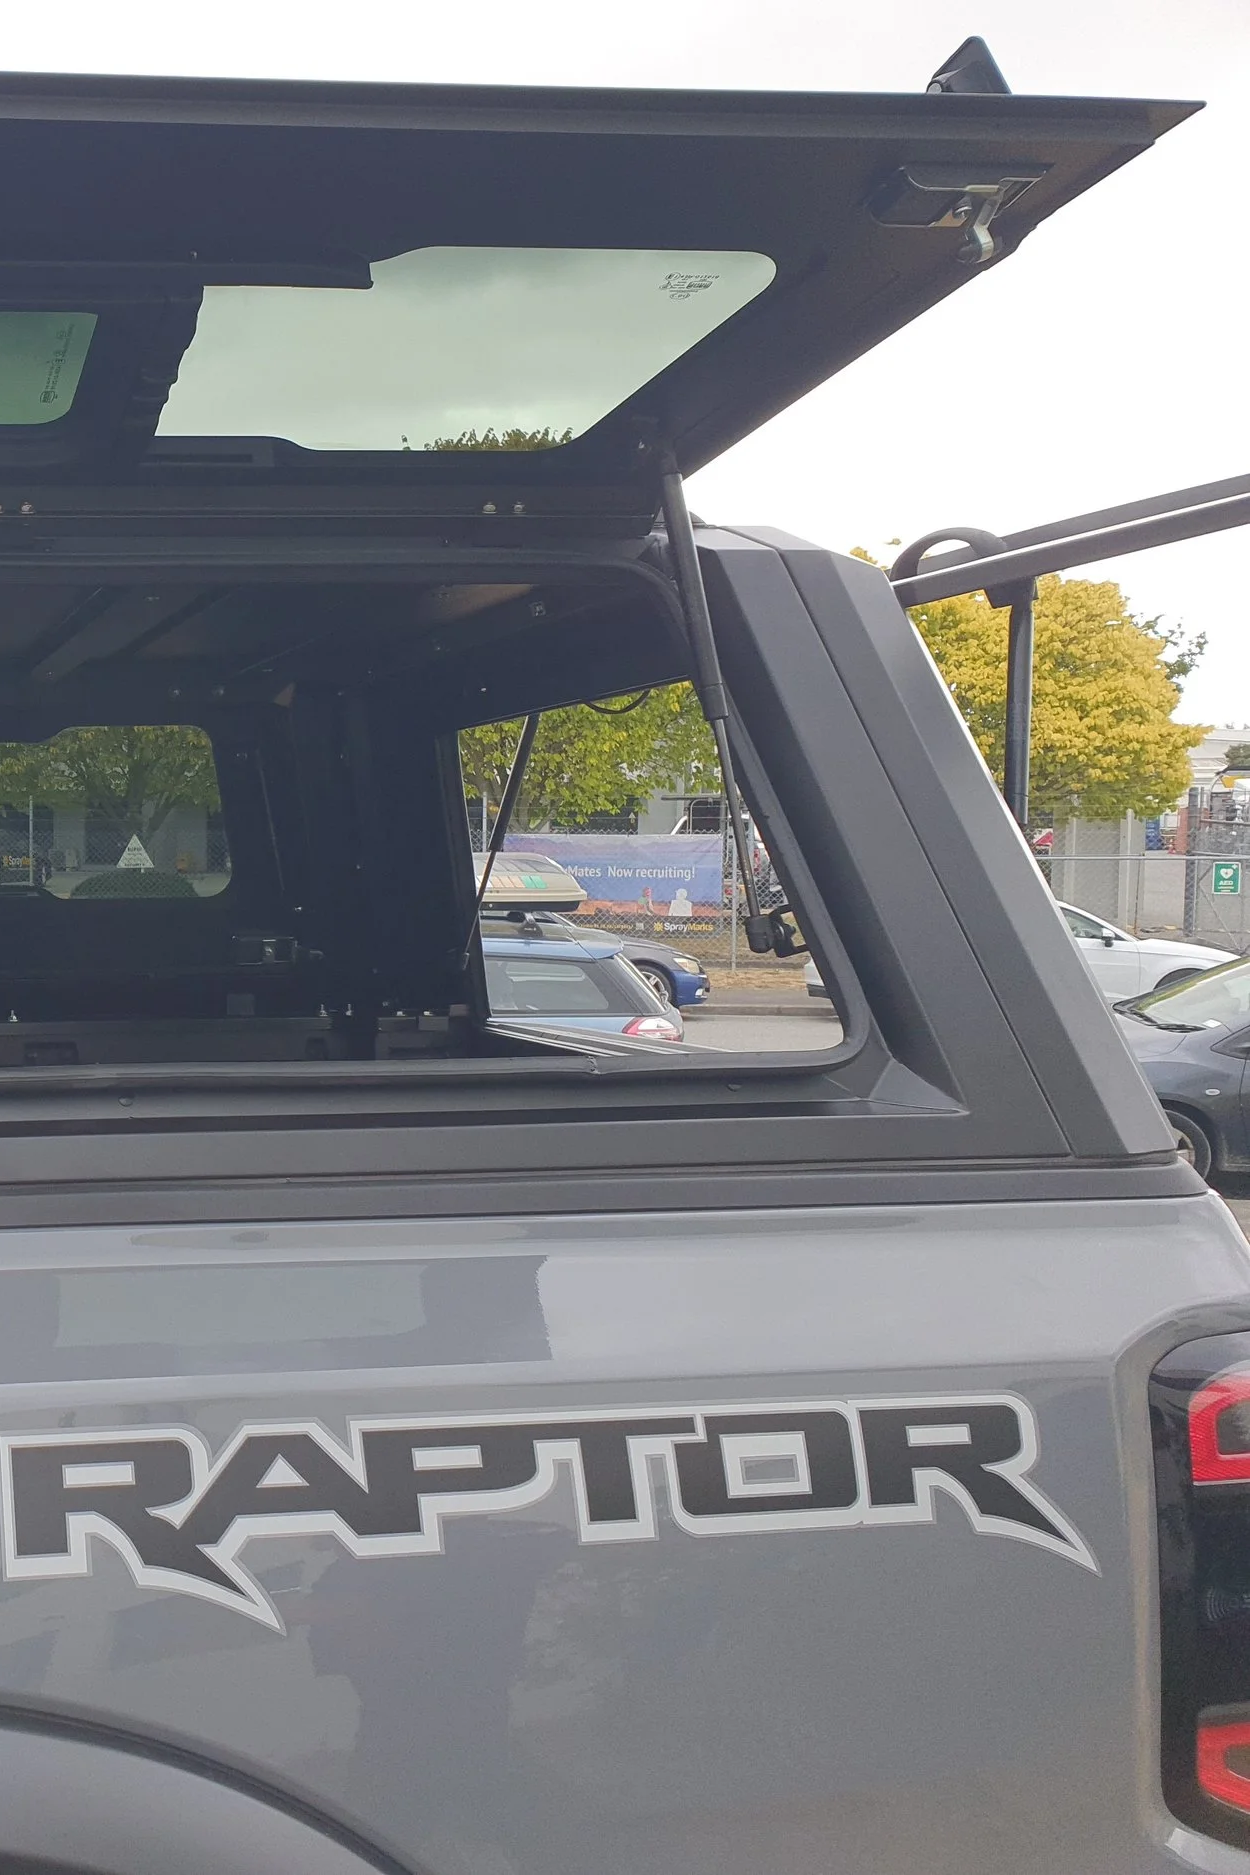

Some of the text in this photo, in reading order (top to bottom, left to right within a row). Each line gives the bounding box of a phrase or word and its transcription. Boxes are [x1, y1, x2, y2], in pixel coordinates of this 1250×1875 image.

[607, 865, 633, 878] Now
[635, 866, 695, 880] recruiting!
[664, 922, 714, 932] SprayMarks
[0, 1393, 1101, 1633] RAPTOR
